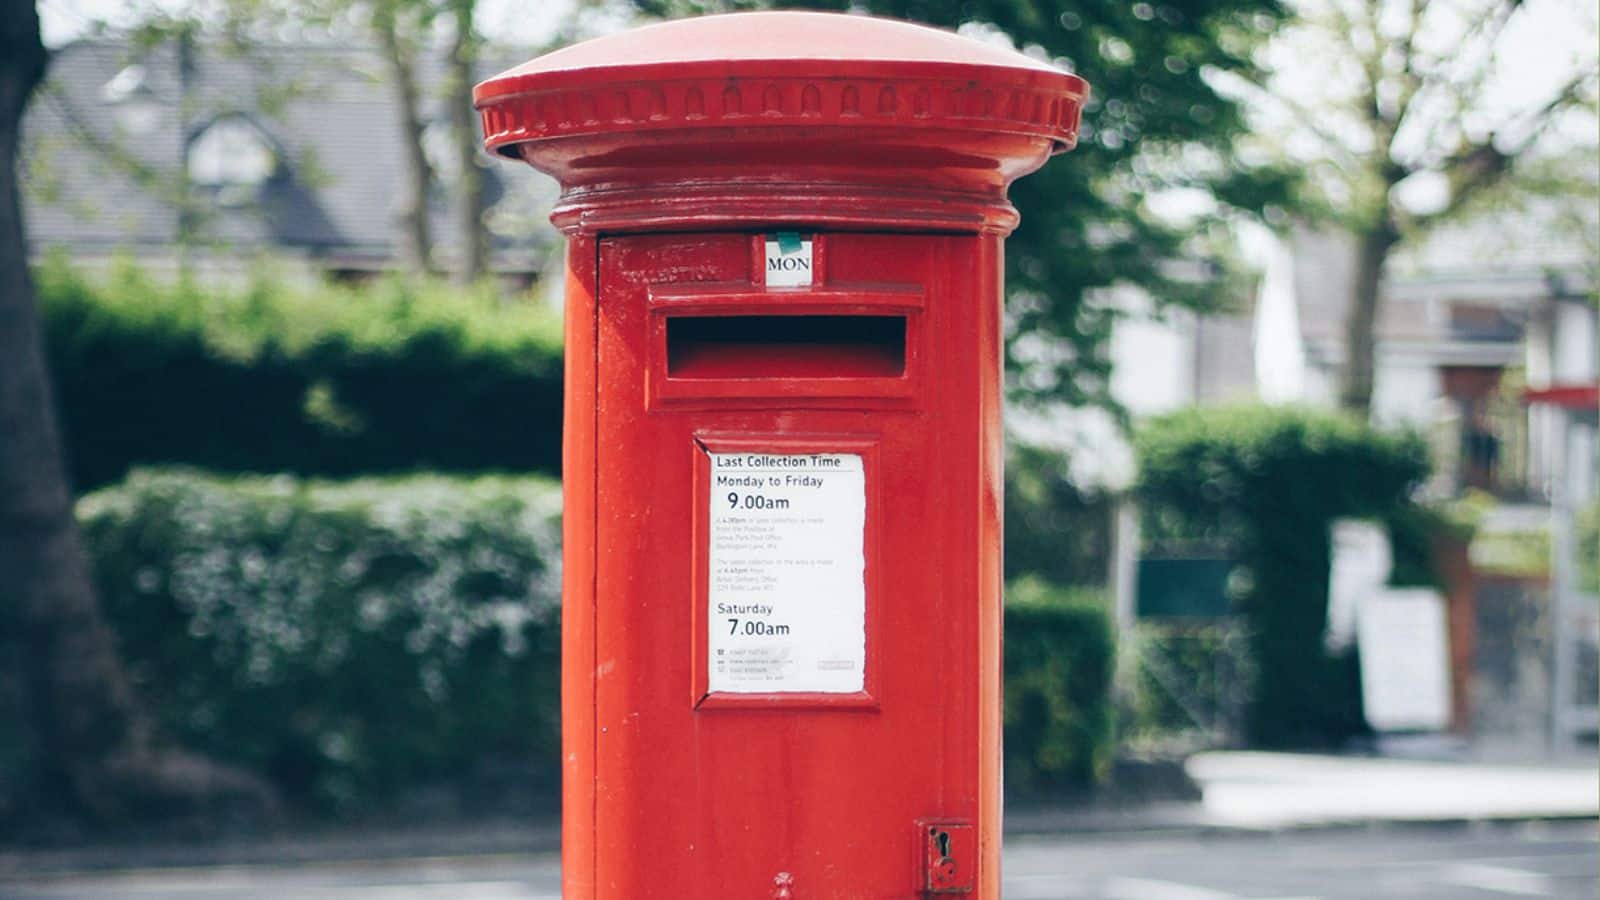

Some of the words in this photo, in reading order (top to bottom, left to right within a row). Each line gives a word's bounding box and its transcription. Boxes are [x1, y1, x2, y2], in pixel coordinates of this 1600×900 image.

[768, 258, 809, 271] MON
[717, 456, 742, 467] Last
[747, 456, 806, 467] Collection
[810, 456, 841, 467] Time
[717, 475, 765, 488] Monday
[768, 476, 781, 487] to
[786, 475, 823, 488] Friday
[728, 492, 789, 509] 9.00am
[717, 602, 773, 616] Saturday
[728, 619, 789, 635] 7.00am
